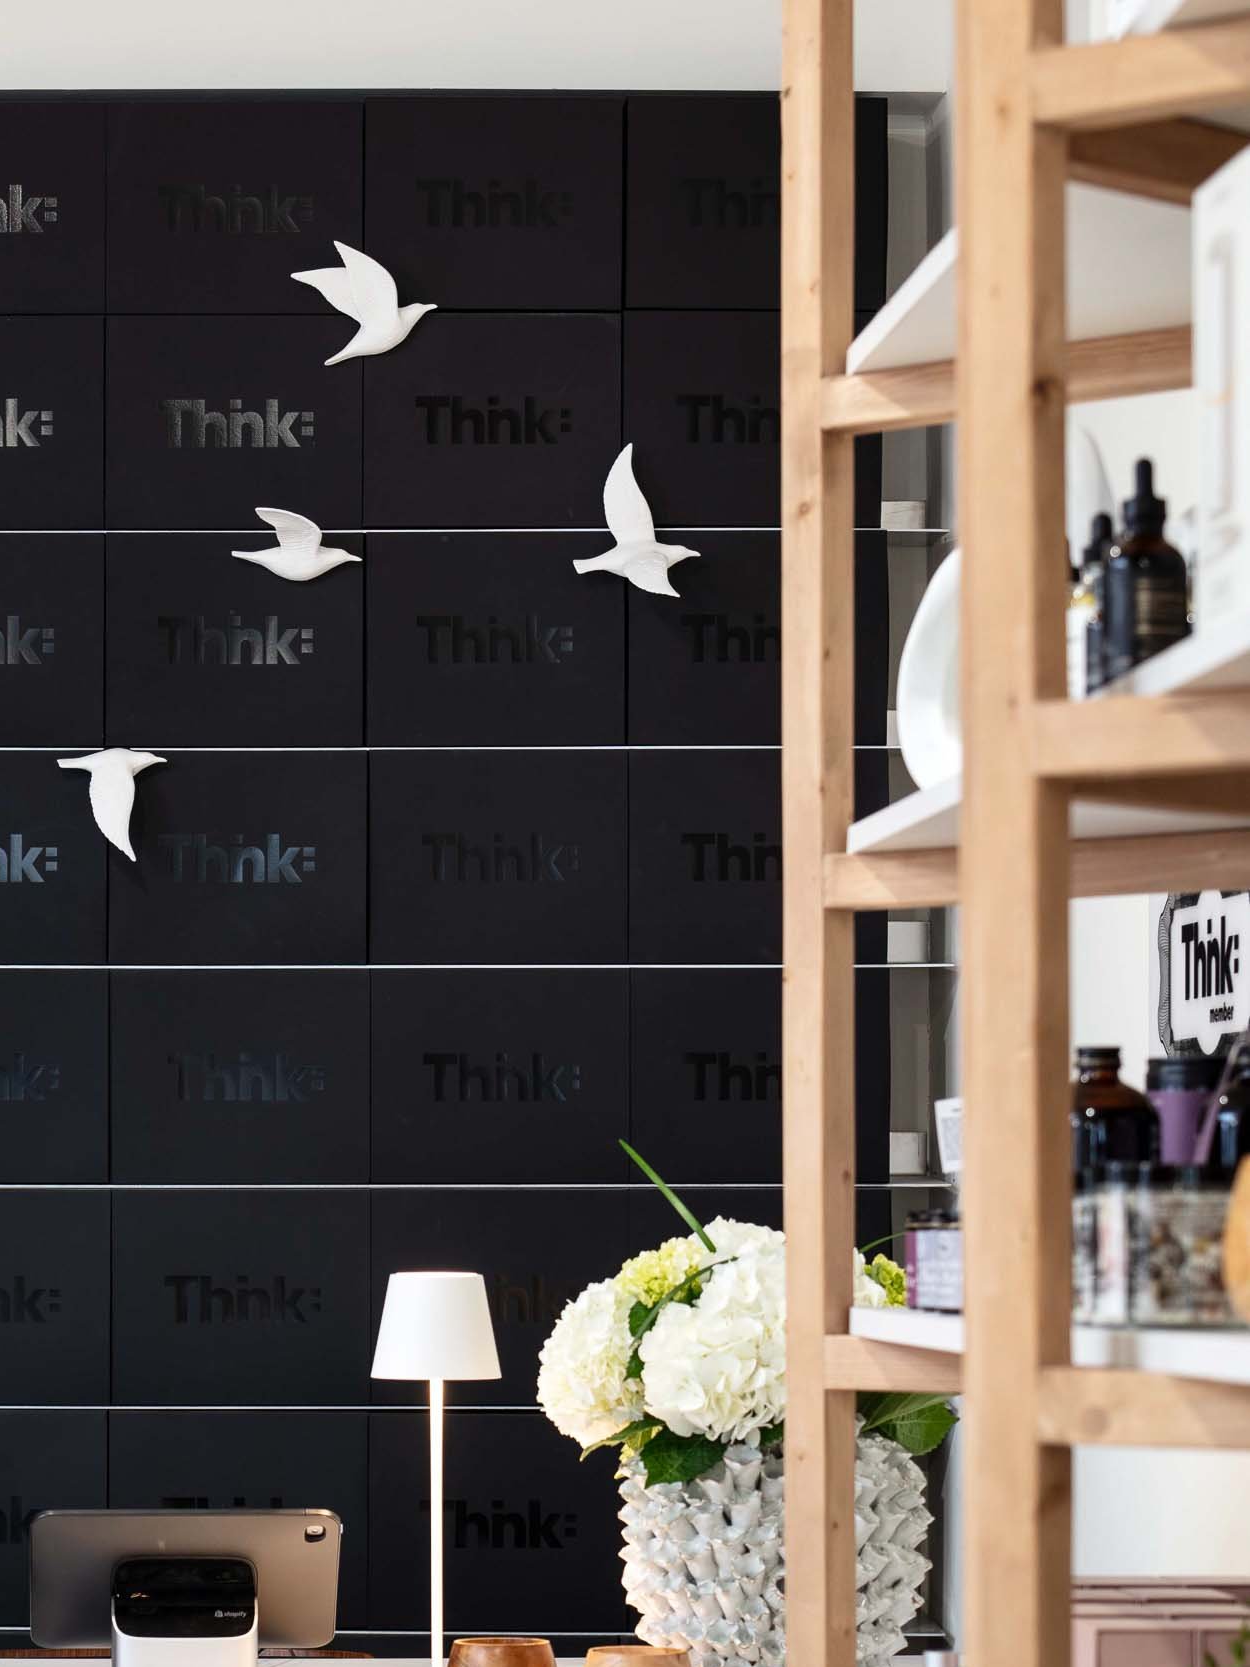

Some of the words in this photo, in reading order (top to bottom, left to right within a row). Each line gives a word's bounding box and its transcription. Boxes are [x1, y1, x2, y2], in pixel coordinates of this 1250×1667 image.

[157, 183, 314, 233] Think:
[416, 178, 574, 228] Think:
[159, 398, 314, 447] Think:
[416, 396, 571, 444] Think:
[158, 615, 313, 666] Think:
[416, 615, 573, 665] Think:
[158, 833, 315, 884] Think:
[422, 833, 580, 883] Think:
[1182, 916, 1239, 1000] Think:
[1210, 1002, 1234, 1023] member
[167, 1053, 325, 1102] Think:
[422, 1052, 581, 1102] Think:
[165, 1275, 322, 1325] Think:
